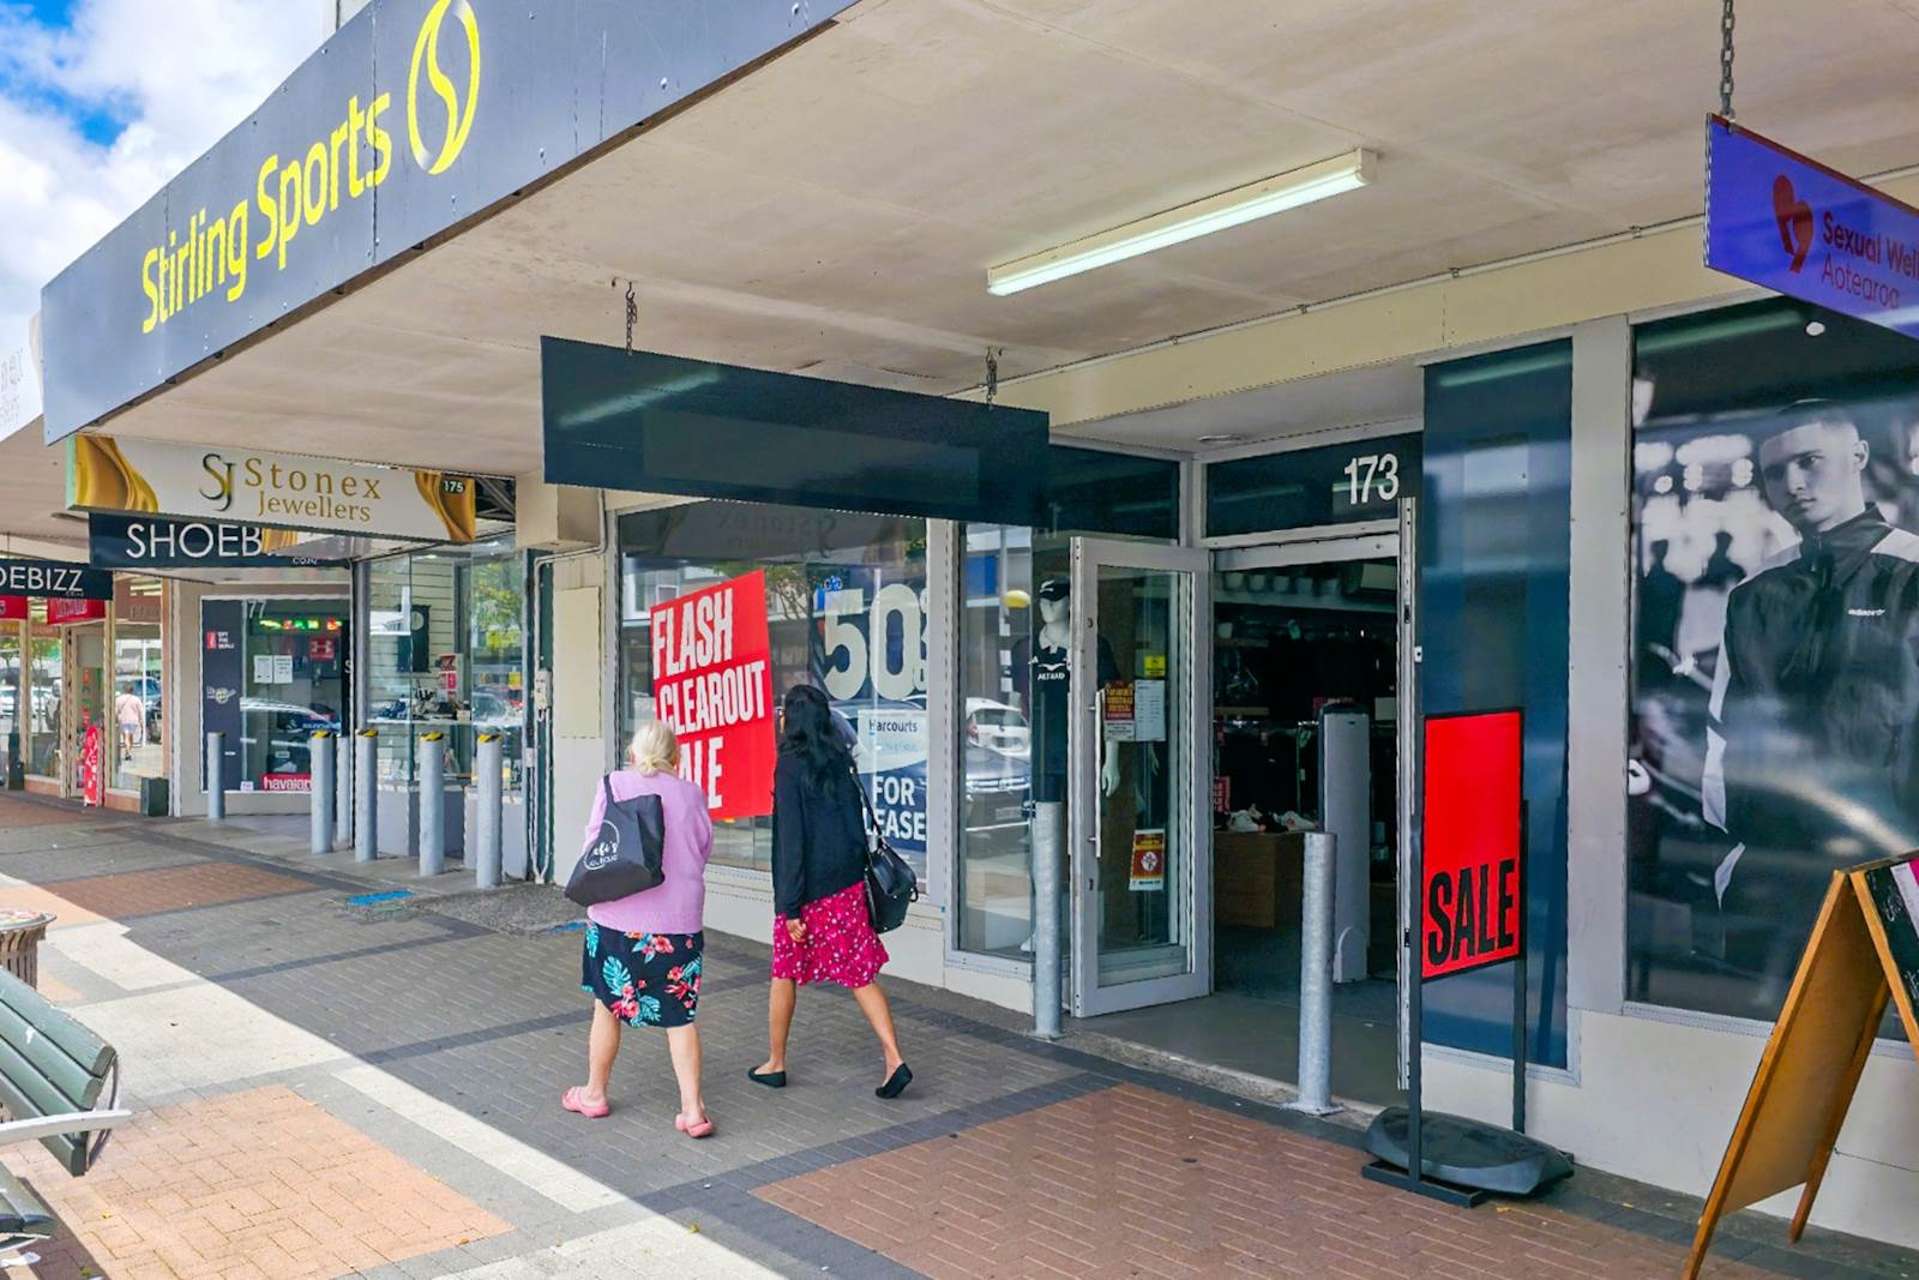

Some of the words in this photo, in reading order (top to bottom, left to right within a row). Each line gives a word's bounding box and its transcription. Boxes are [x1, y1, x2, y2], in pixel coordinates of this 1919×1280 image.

[143, 199, 248, 333] Stirling
[256, 93, 391, 270] Sports
[1823, 211, 1882, 265] Sexual
[244, 457, 381, 500] Stonex
[444, 480, 464, 493] 175
[1344, 453, 1399, 505] 173
[259, 491, 371, 522] Jewellers
[126, 523, 264, 558] SHOEB
[653, 588, 733, 679] FLASH
[660, 660, 765, 736] CLEAROUT
[869, 719, 918, 733] Harcourts
[679, 736, 724, 809] ALE
[872, 775, 915, 806] FOR
[863, 808, 927, 841] LEASE
[1428, 859, 1514, 966] SALE
